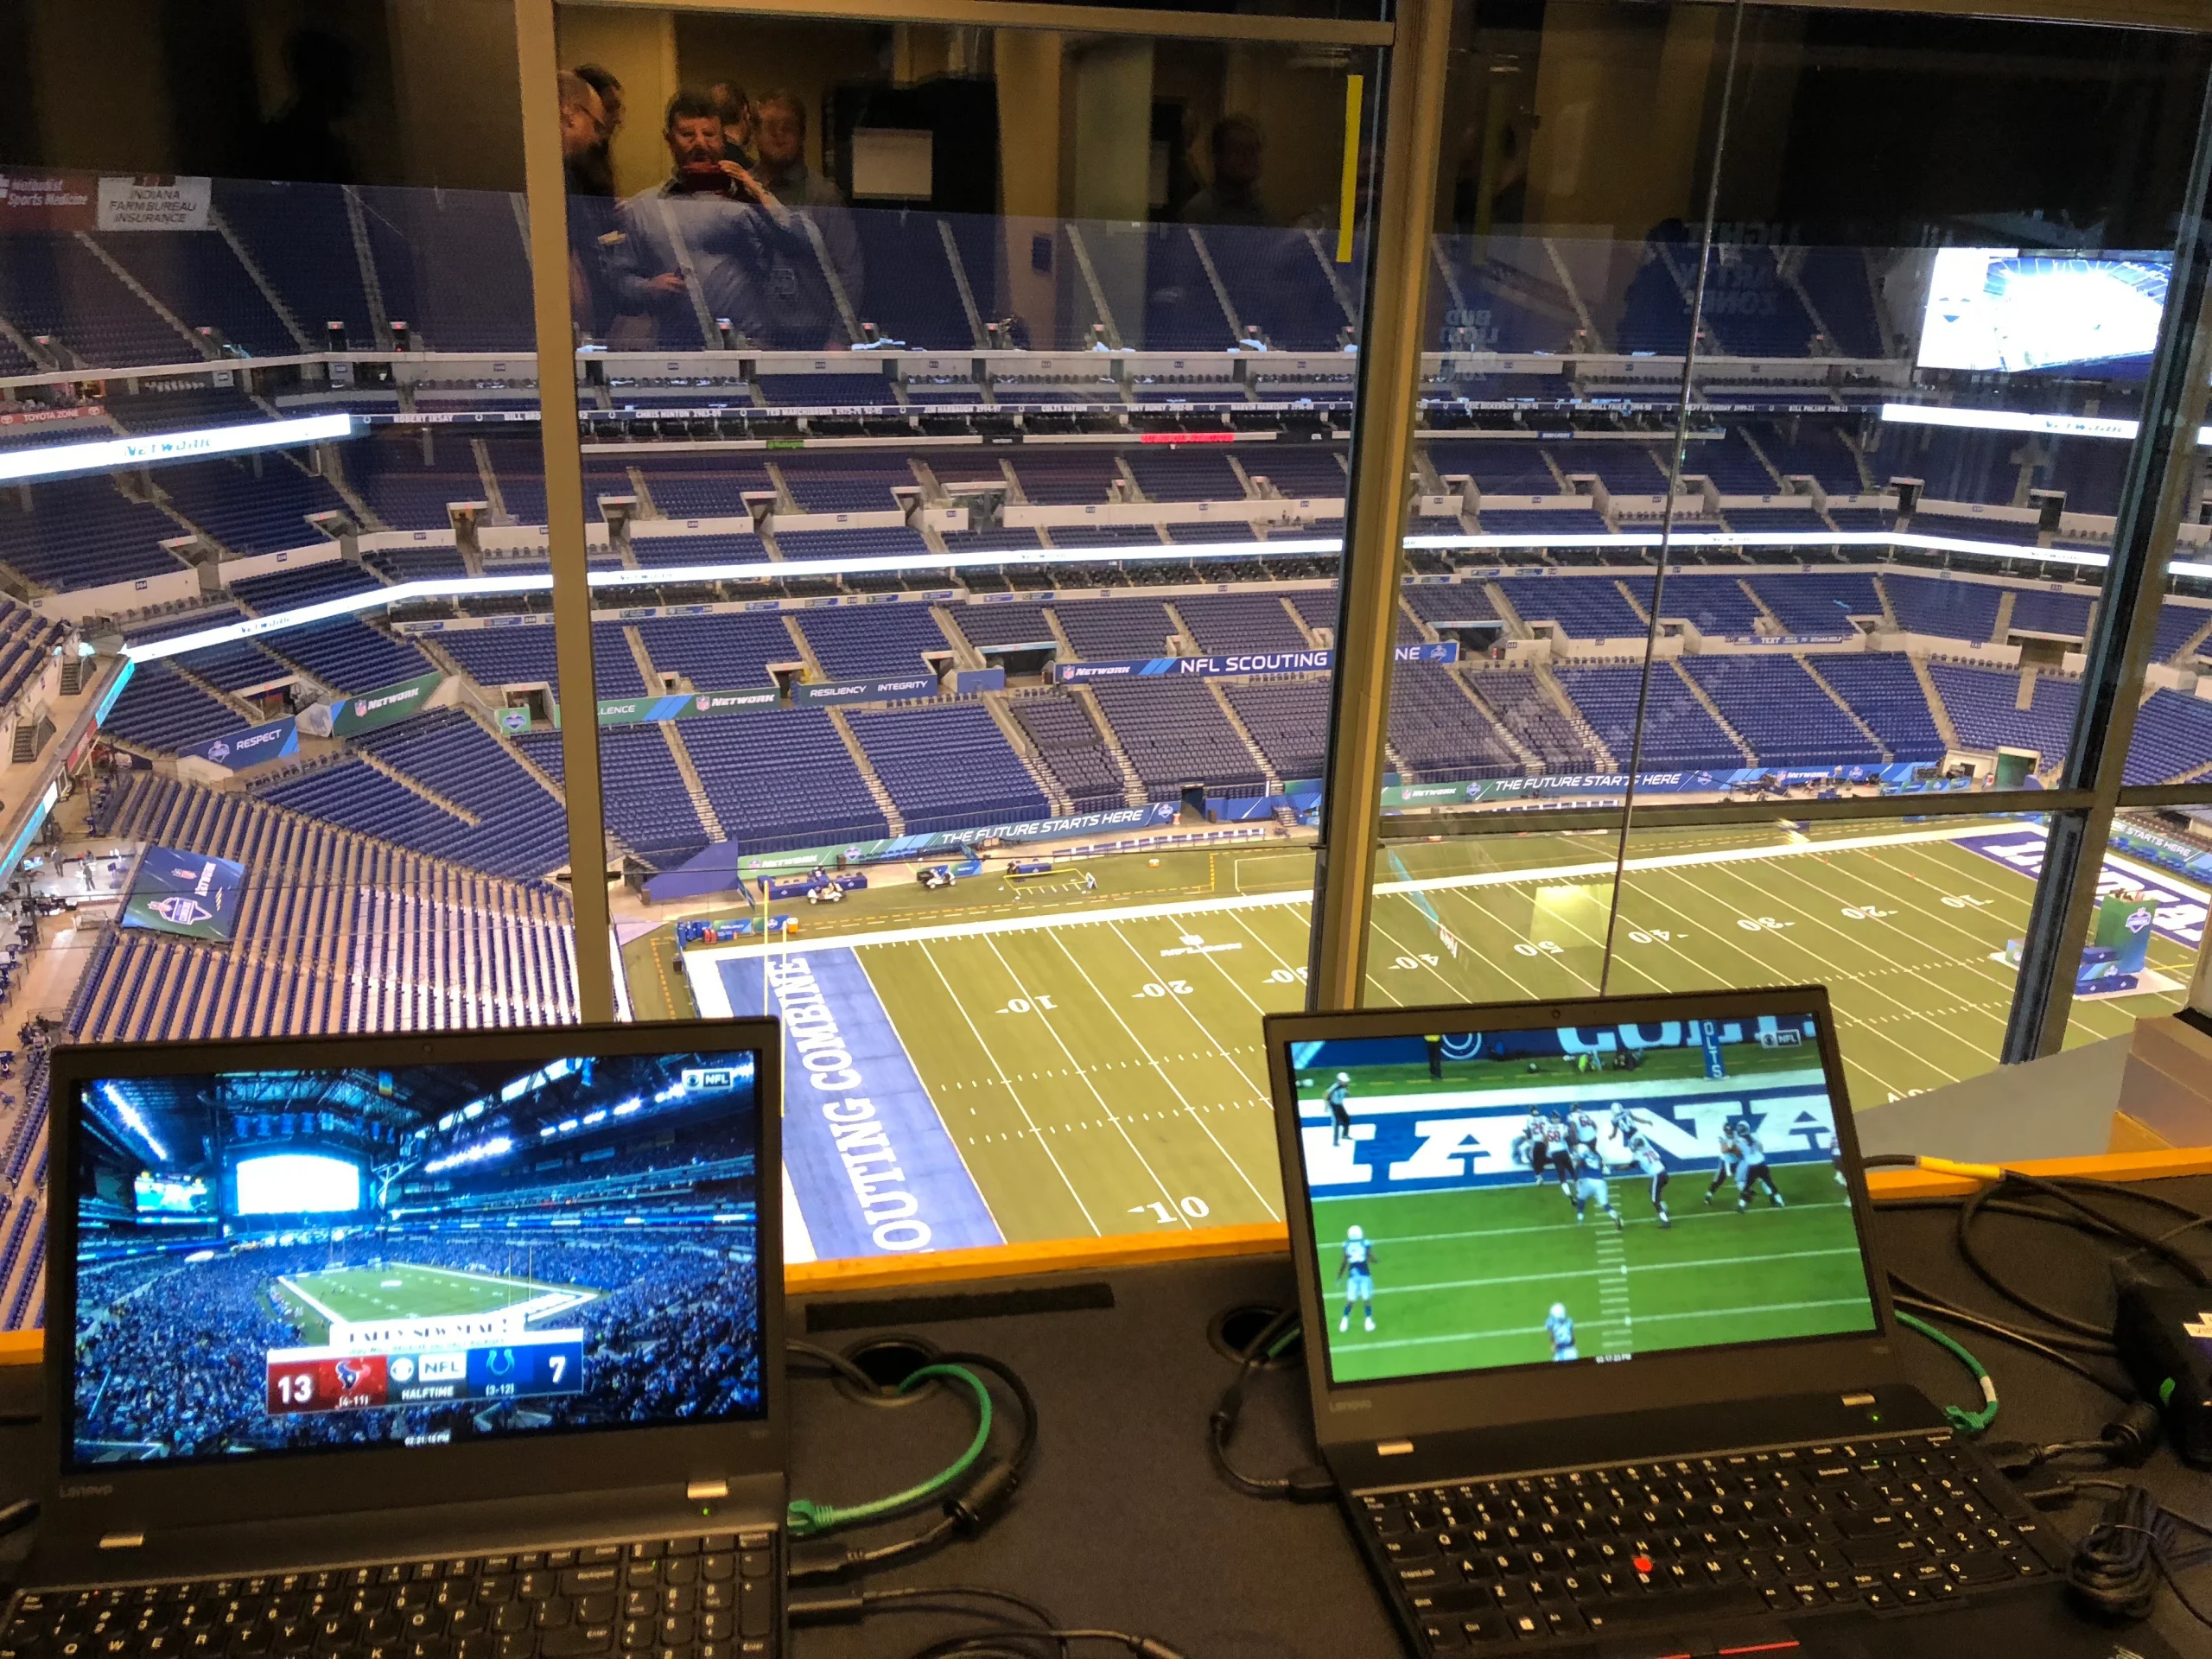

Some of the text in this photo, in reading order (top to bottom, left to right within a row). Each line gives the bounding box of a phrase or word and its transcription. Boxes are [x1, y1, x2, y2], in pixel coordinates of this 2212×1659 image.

[130, 190, 180, 200] INDIANA
[114, 213, 187, 223] INSURANCE
[23, 409, 79, 422] TOYOTA ZONE
[1180, 652, 1328, 674] NFL SCOUTING
[810, 685, 867, 698] RESILIENCY
[877, 680, 928, 692] INTEGRITY
[711, 694, 775, 708] NETWORK
[598, 704, 635, 717] LENCE
[236, 729, 282, 750] RESPECT
[1495, 779, 1522, 792] THE
[1522, 776, 1581, 790] FUTURE
[1642, 773, 1681, 785] HERE
[941, 809, 1145, 845] THE FUTURE STARTS HERE
[2125, 826, 2164, 847] STARTS
[2162, 840, 2192, 858] HERE
[1777, 1033, 1798, 1045] NFL
[705, 1073, 729, 1085] NFL
[764, 957, 934, 1252] OUTING COMBINE
[424, 1359, 461, 1374] NFL
[549, 1355, 567, 1383] 7
[276, 1374, 314, 1406] 13
[401, 1385, 454, 1402] HALFTIME
